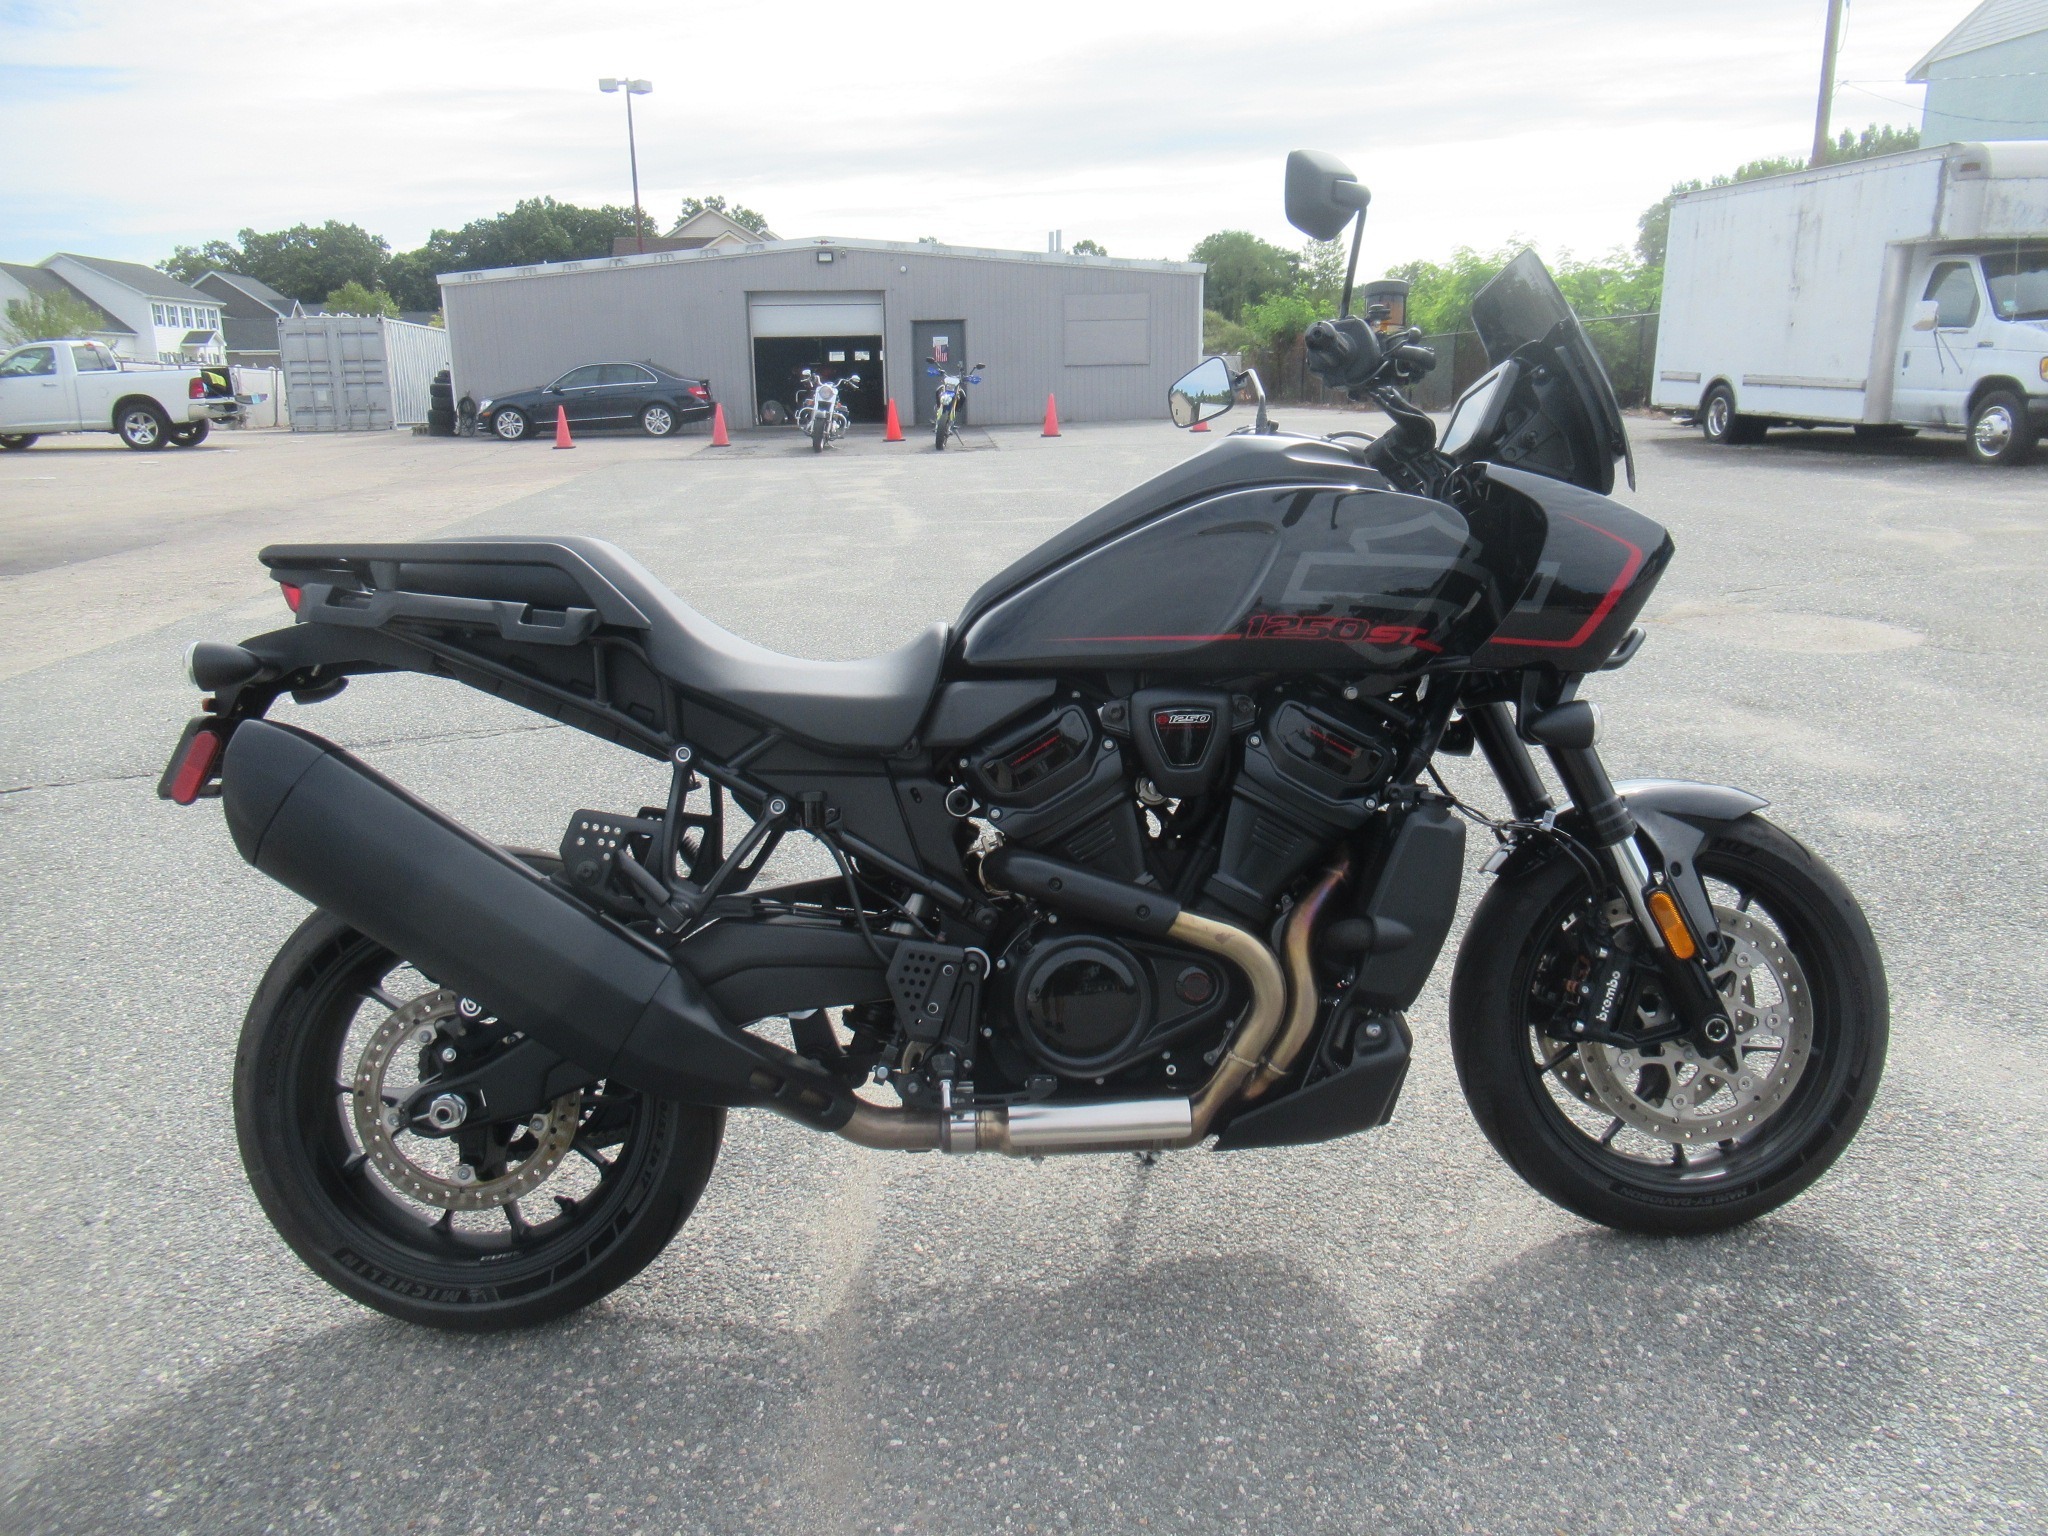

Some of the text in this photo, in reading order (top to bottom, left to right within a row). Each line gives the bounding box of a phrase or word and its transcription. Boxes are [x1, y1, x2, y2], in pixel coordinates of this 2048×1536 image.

[1169, 714, 1210, 723] 1250
[1595, 971, 1621, 1021] brembo
[341, 1252, 461, 1302] MICHELIN
